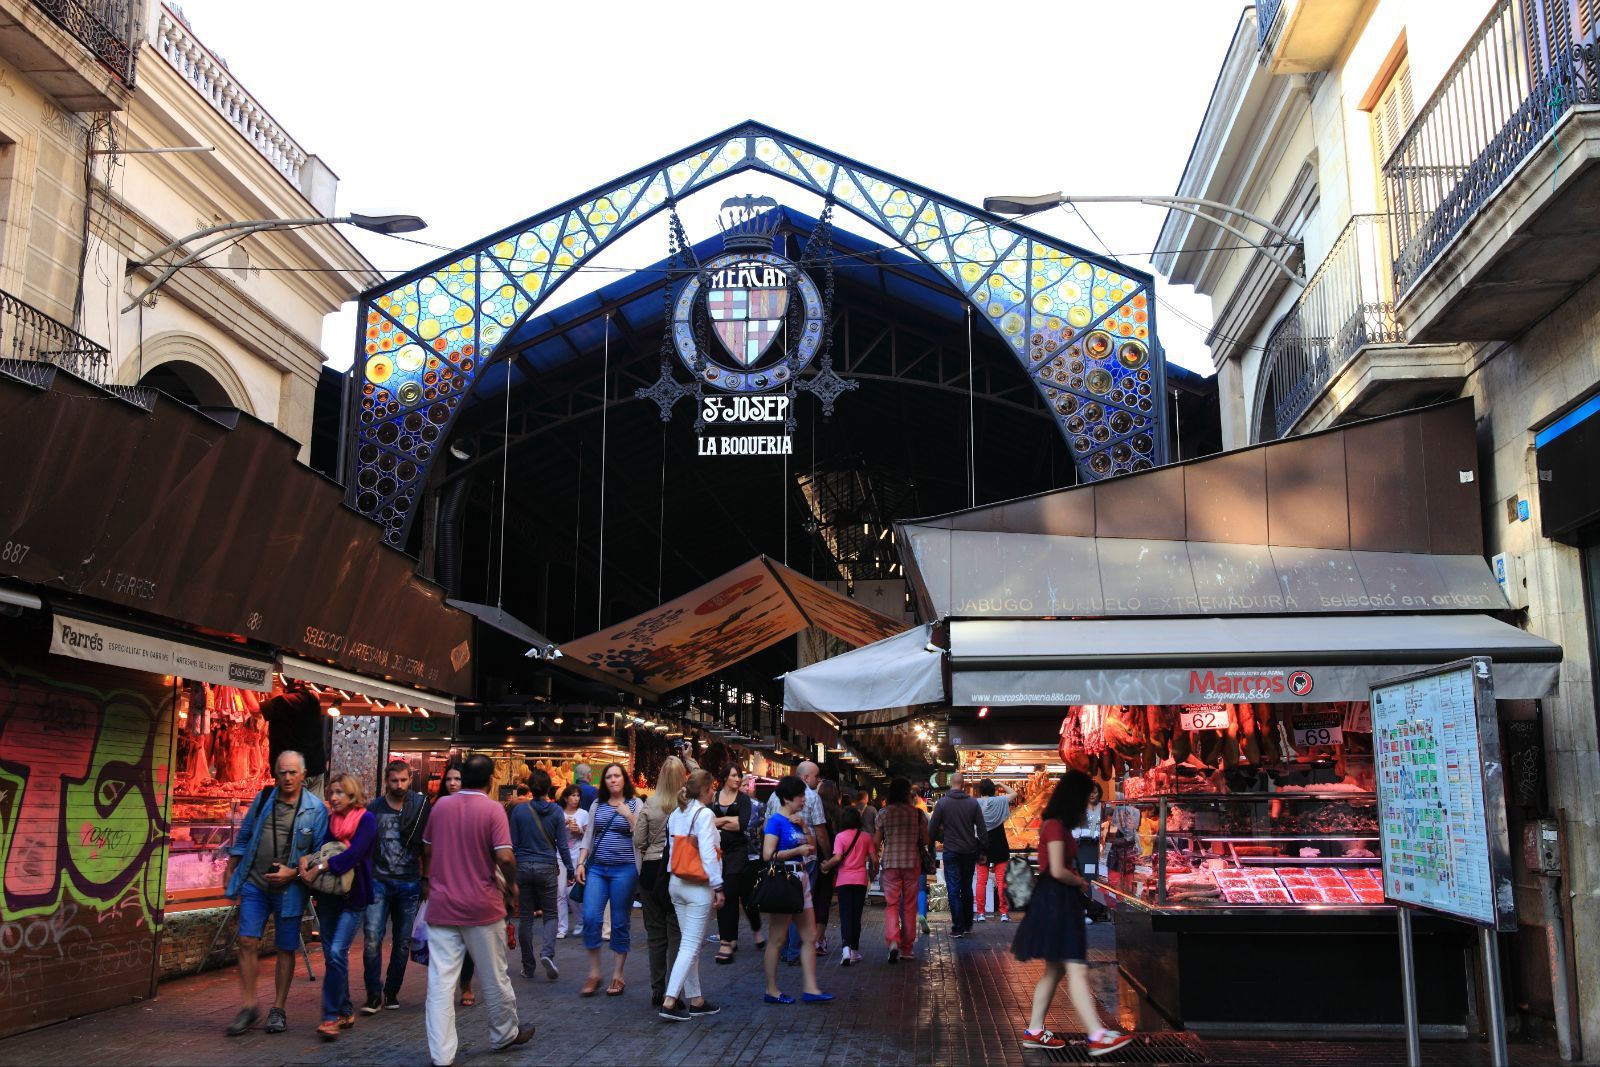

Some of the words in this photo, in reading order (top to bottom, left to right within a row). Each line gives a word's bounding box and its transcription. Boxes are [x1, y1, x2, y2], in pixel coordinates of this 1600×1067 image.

[722, 396, 789, 421] JOSEP
[698, 437, 717, 455] LA
[721, 436, 792, 455] BOQUERIA
[2, 541, 31, 565] 887
[956, 598, 1033, 612] JABUGO
[1148, 594, 1299, 611] EXTREMADURA
[1401, 595, 1427, 606] en
[1432, 592, 1491, 607] origen
[108, 642, 142, 656] ESPECIALITAT
[230, 666, 246, 678] CASA
[1188, 671, 1285, 694] Marcos
[1193, 713, 1217, 729] 62
[1305, 729, 1330, 745] 69
